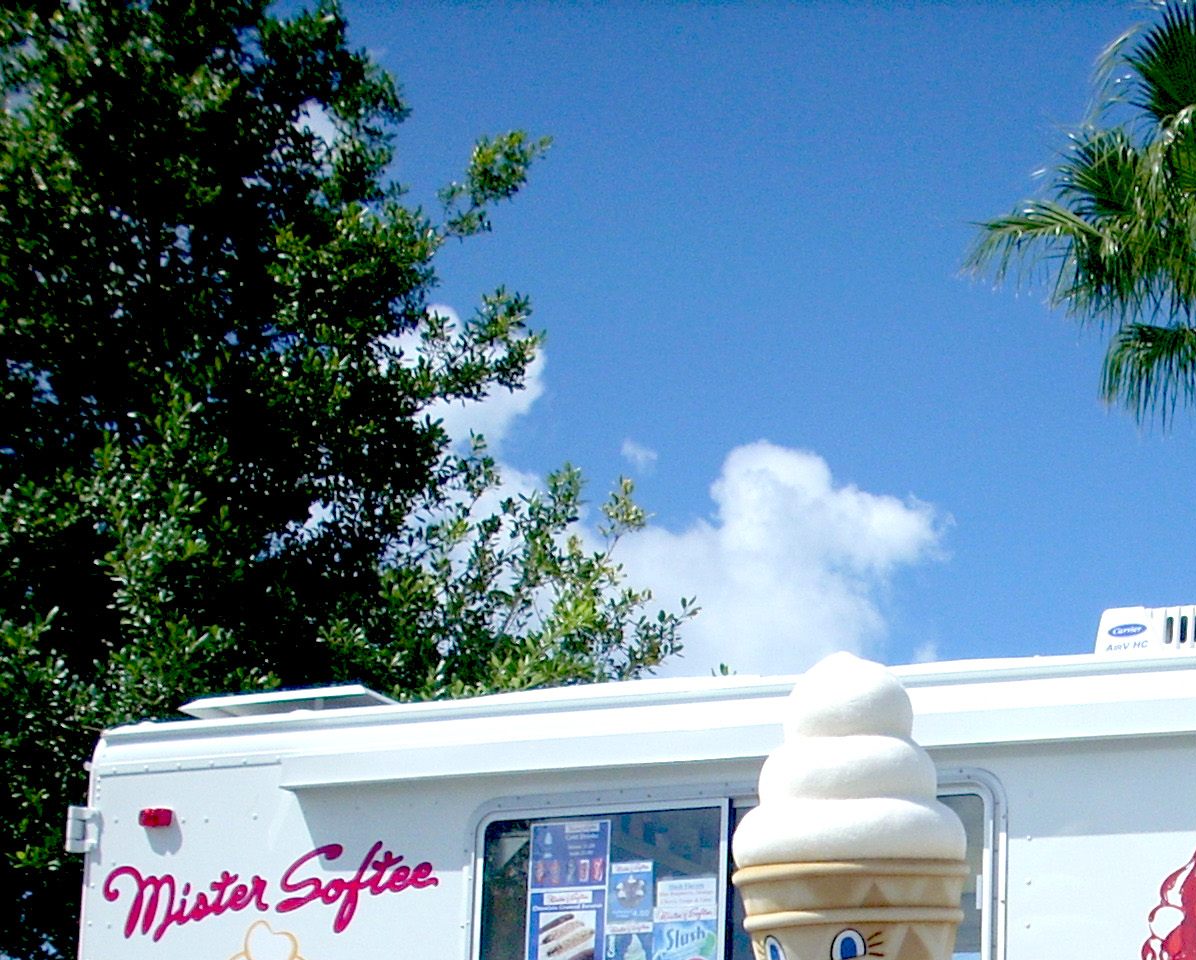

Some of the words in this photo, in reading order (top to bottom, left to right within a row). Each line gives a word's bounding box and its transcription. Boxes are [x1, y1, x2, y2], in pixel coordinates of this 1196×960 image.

[103, 864, 269, 941] Mister
[275, 841, 439, 935] Softee
[666, 925, 706, 950] Slush
